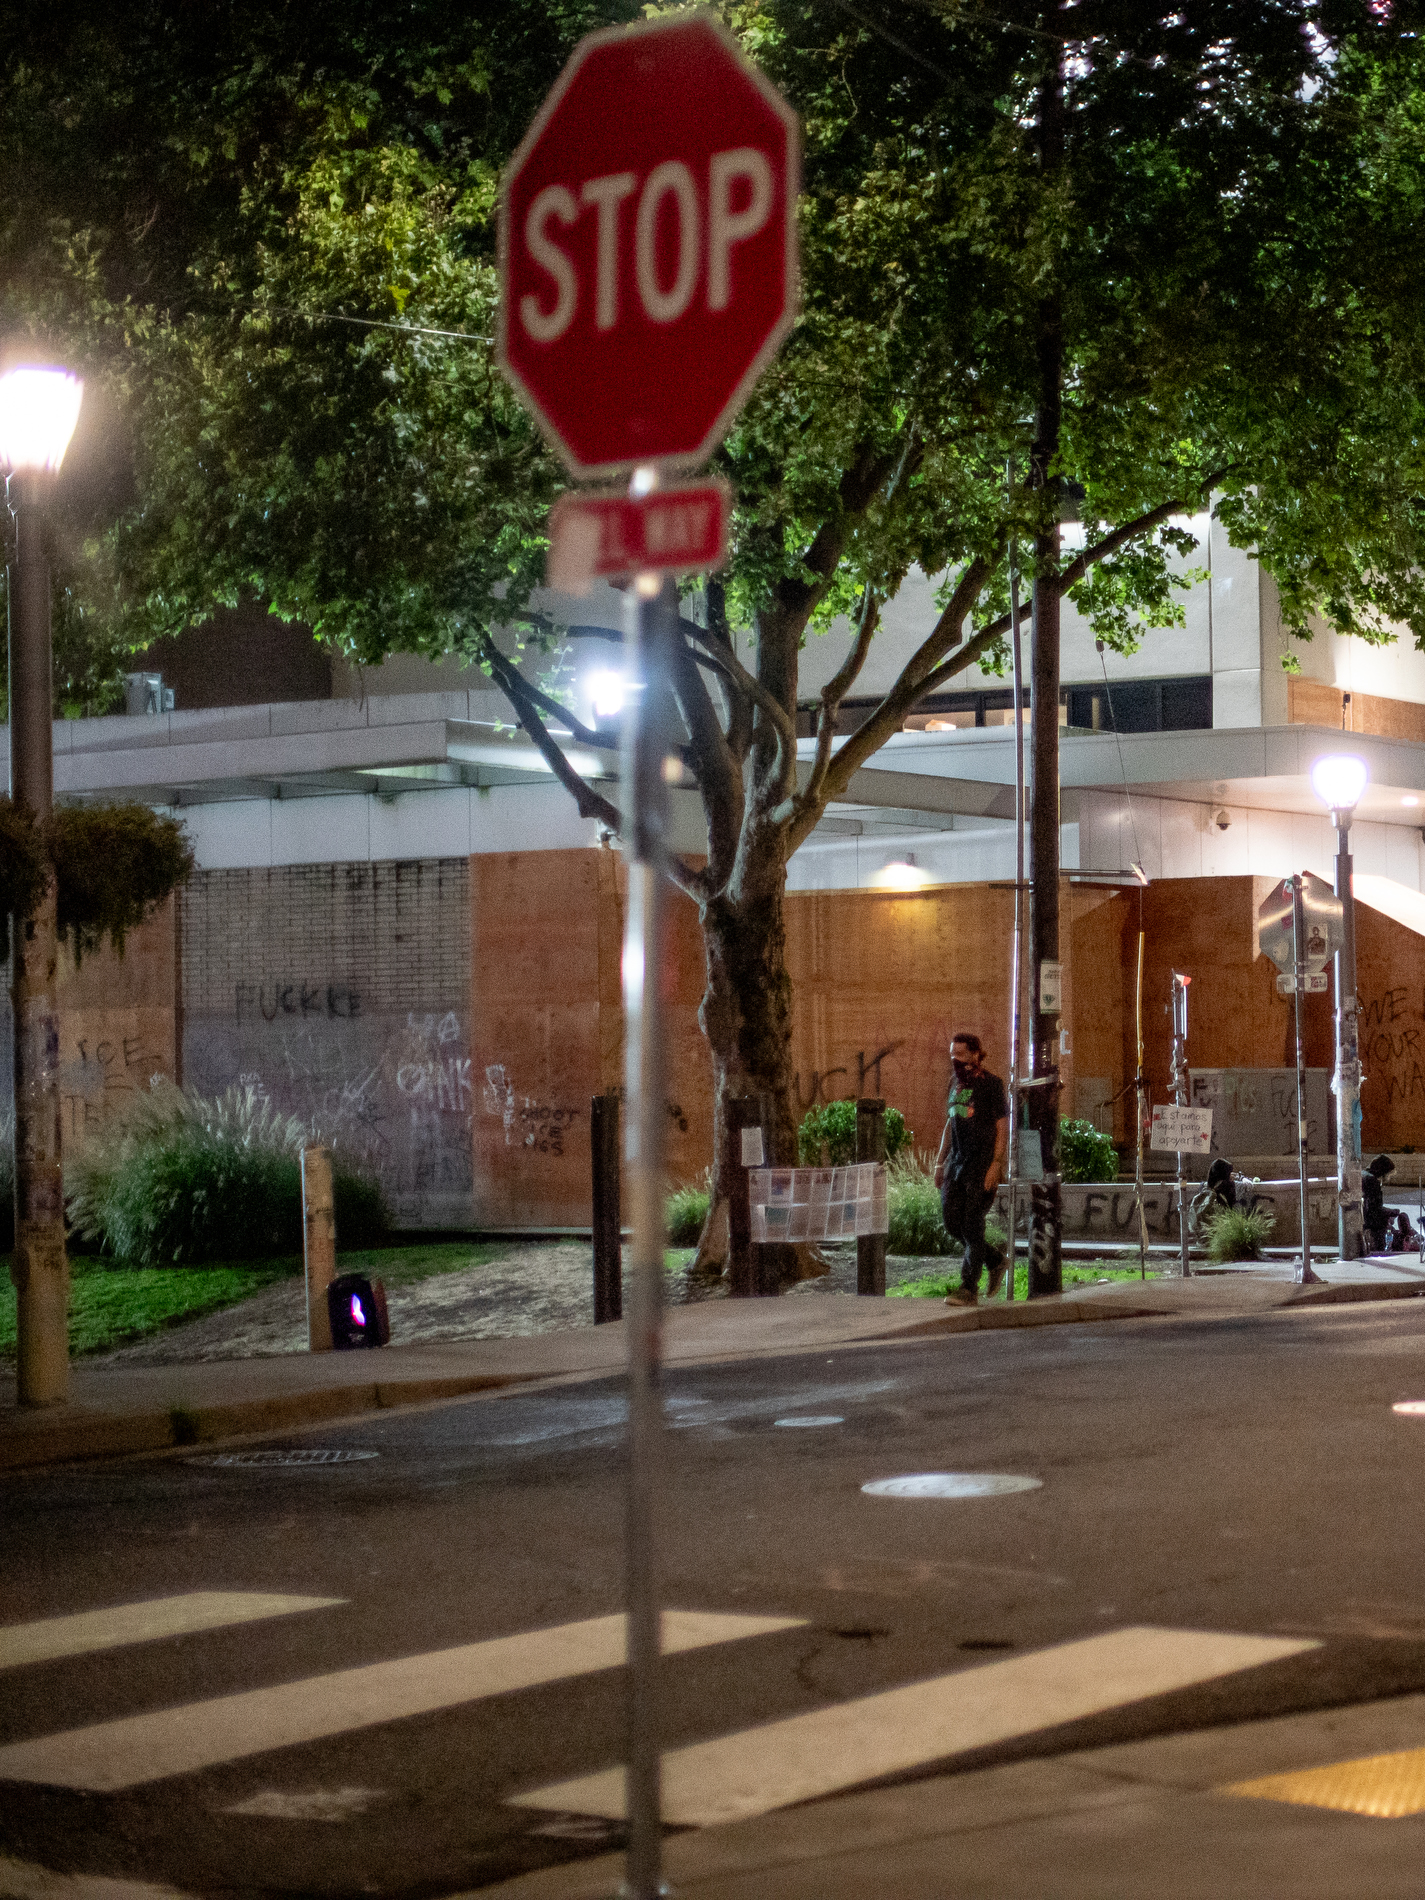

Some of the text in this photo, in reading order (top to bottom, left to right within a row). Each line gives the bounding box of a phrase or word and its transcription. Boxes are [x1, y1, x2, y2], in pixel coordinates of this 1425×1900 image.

[518, 146, 774, 344] STOP
[1358, 986, 1408, 1027] WE
[1366, 1029, 1422, 1073] YOUR
[1160, 1109, 1208, 1122] Estamos
[1180, 1123, 1201, 1135] para
